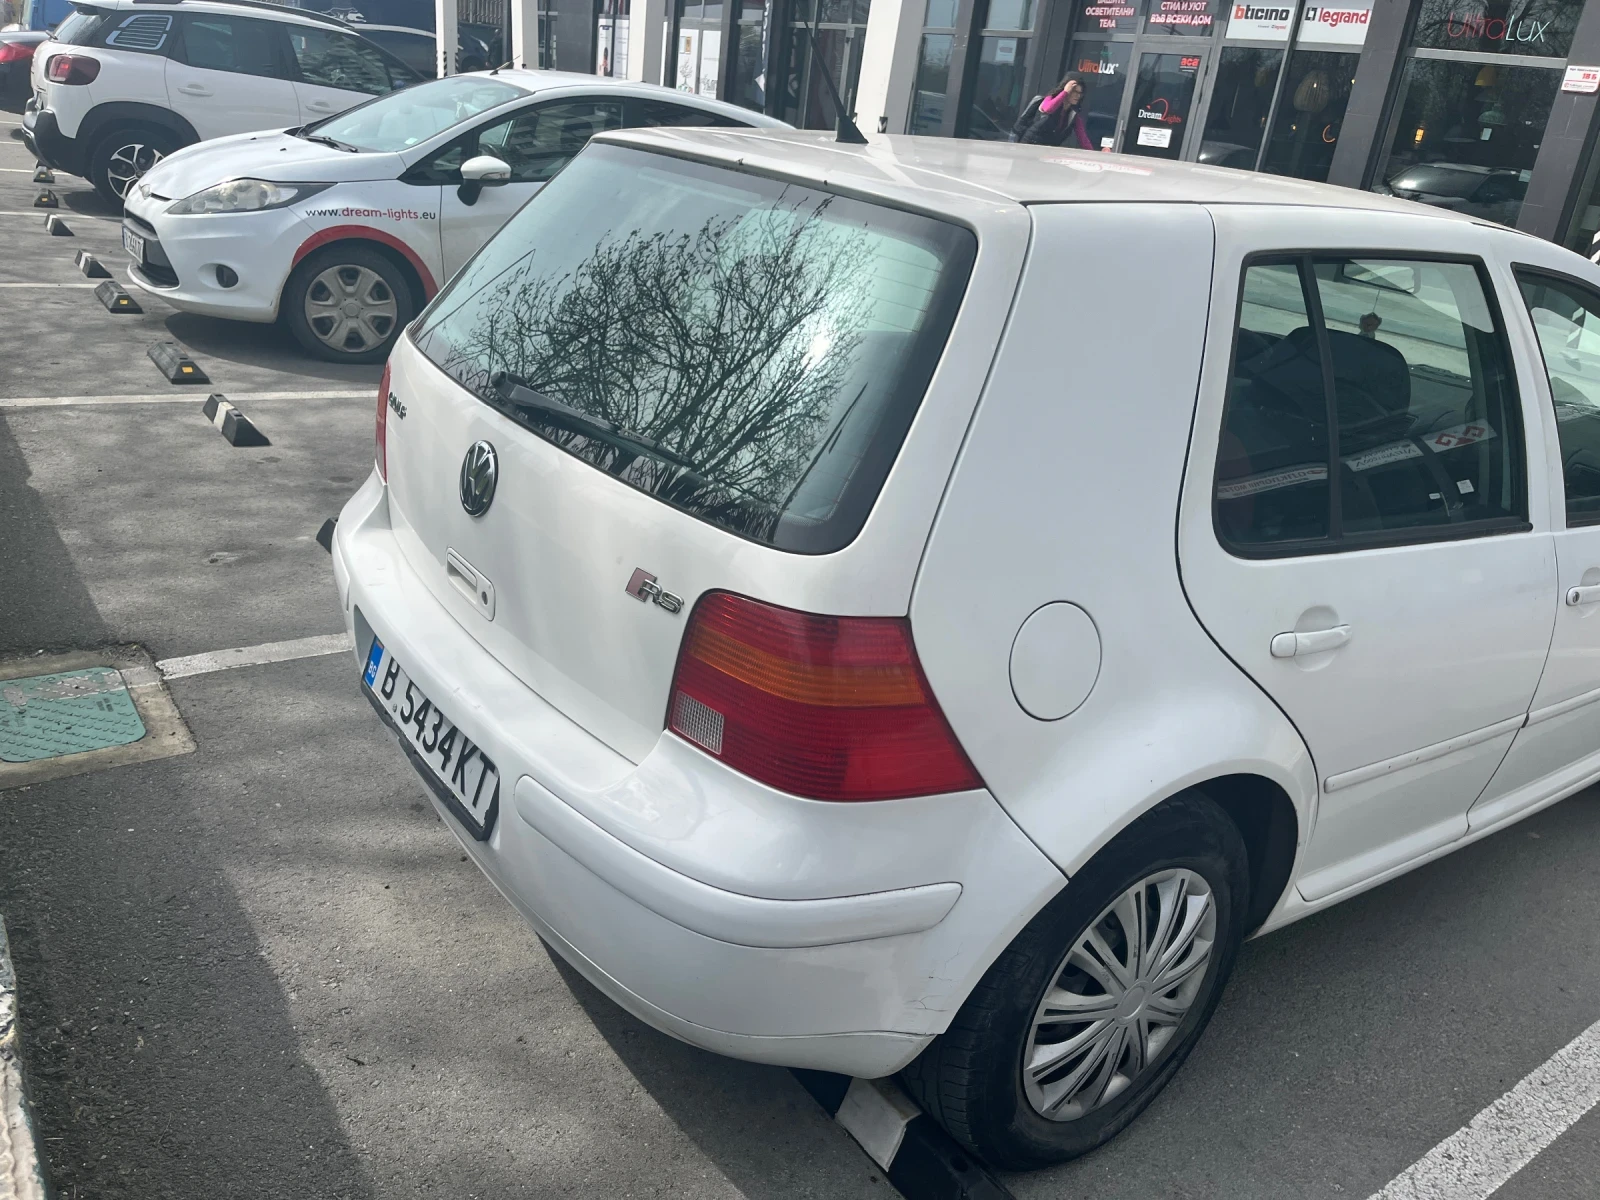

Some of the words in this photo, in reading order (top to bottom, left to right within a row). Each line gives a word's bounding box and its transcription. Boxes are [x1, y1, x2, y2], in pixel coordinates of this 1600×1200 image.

[1085, 7, 1135, 16] ОСВЕТИТЕЛНИ
[1160, 2, 1180, 11] СТИЛ
[1187, 2, 1206, 11] УЮТ
[1234, 4, 1290, 20] bticino
[1099, 19, 1116, 28] ТЕЛА
[1150, 13, 1165, 23] ВЪВ
[1165, 14, 1191, 24] ВСЕКИ
[1191, 15, 1212, 26] ДОМ
[1318, 7, 1370, 27] legrand
[1138, 109, 1162, 120] Dream
[305, 206, 436, 221] www.dream-lights.eu
[368, 661, 377, 679] BG
